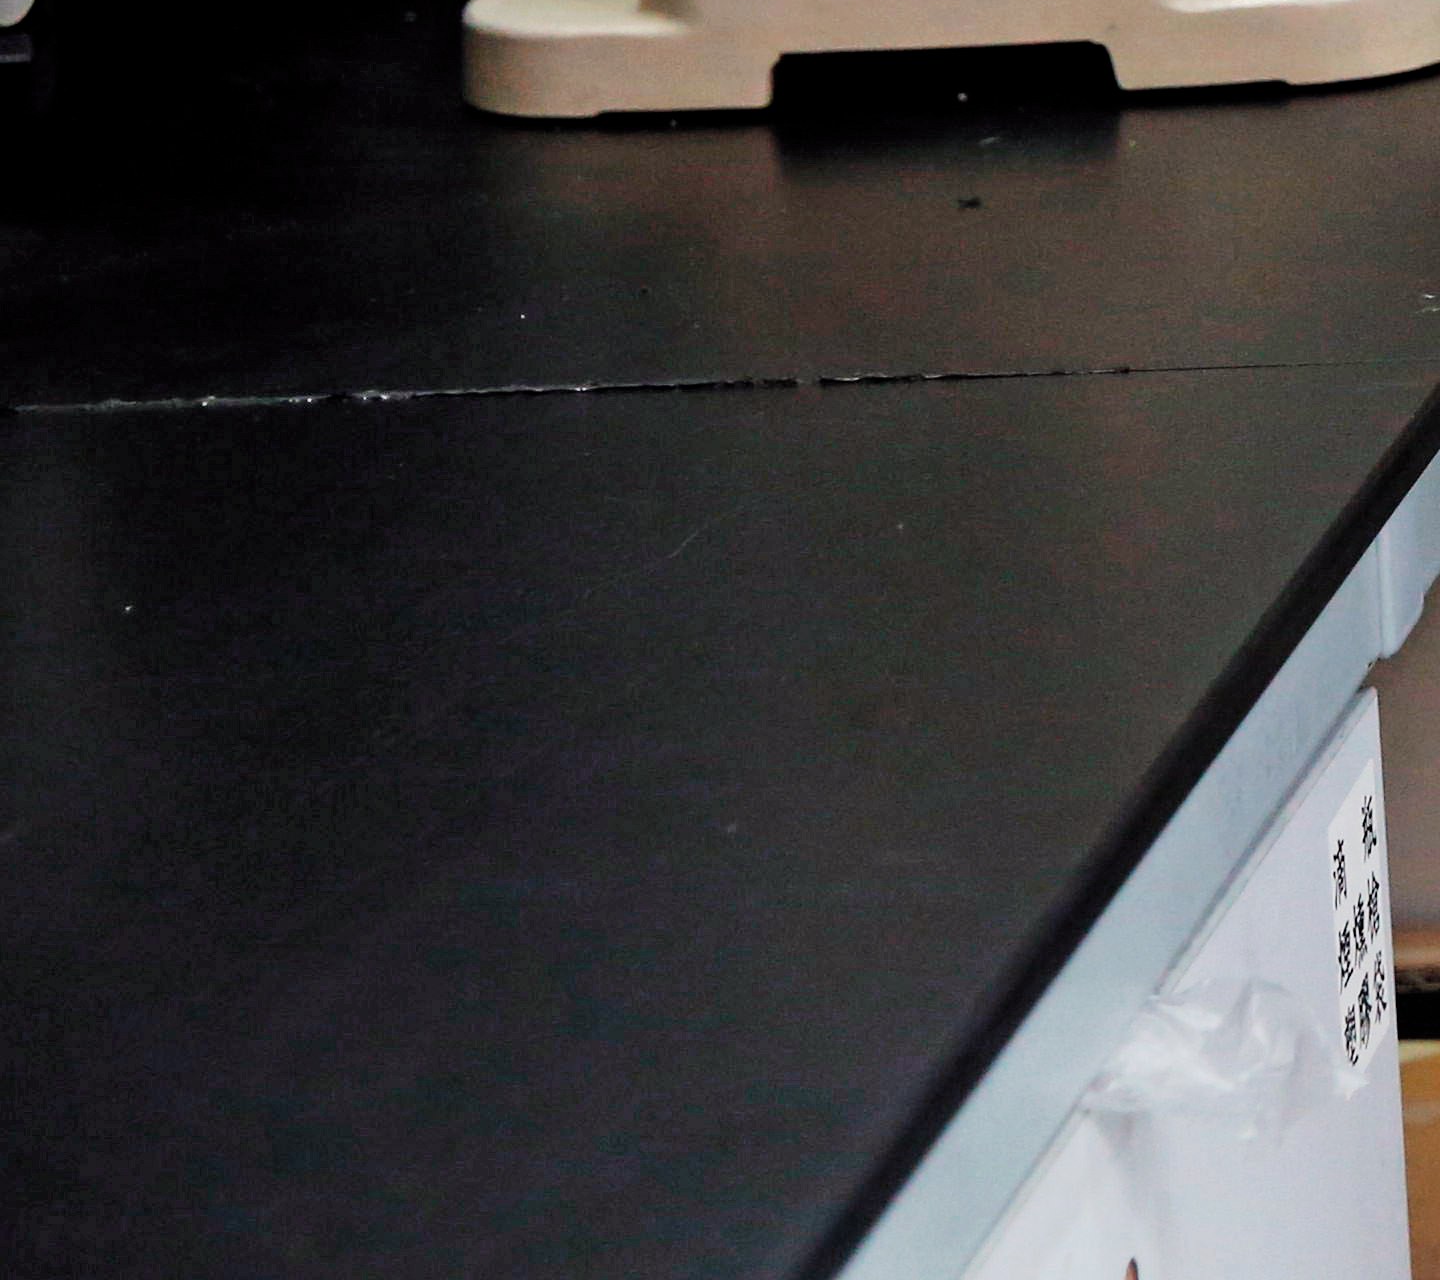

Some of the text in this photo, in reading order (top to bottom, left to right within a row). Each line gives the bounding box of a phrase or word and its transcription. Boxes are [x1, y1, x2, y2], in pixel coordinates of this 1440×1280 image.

[1333, 794, 1378, 910] 滴瓶
[1344, 949, 1388, 1067] 塑膠袋
